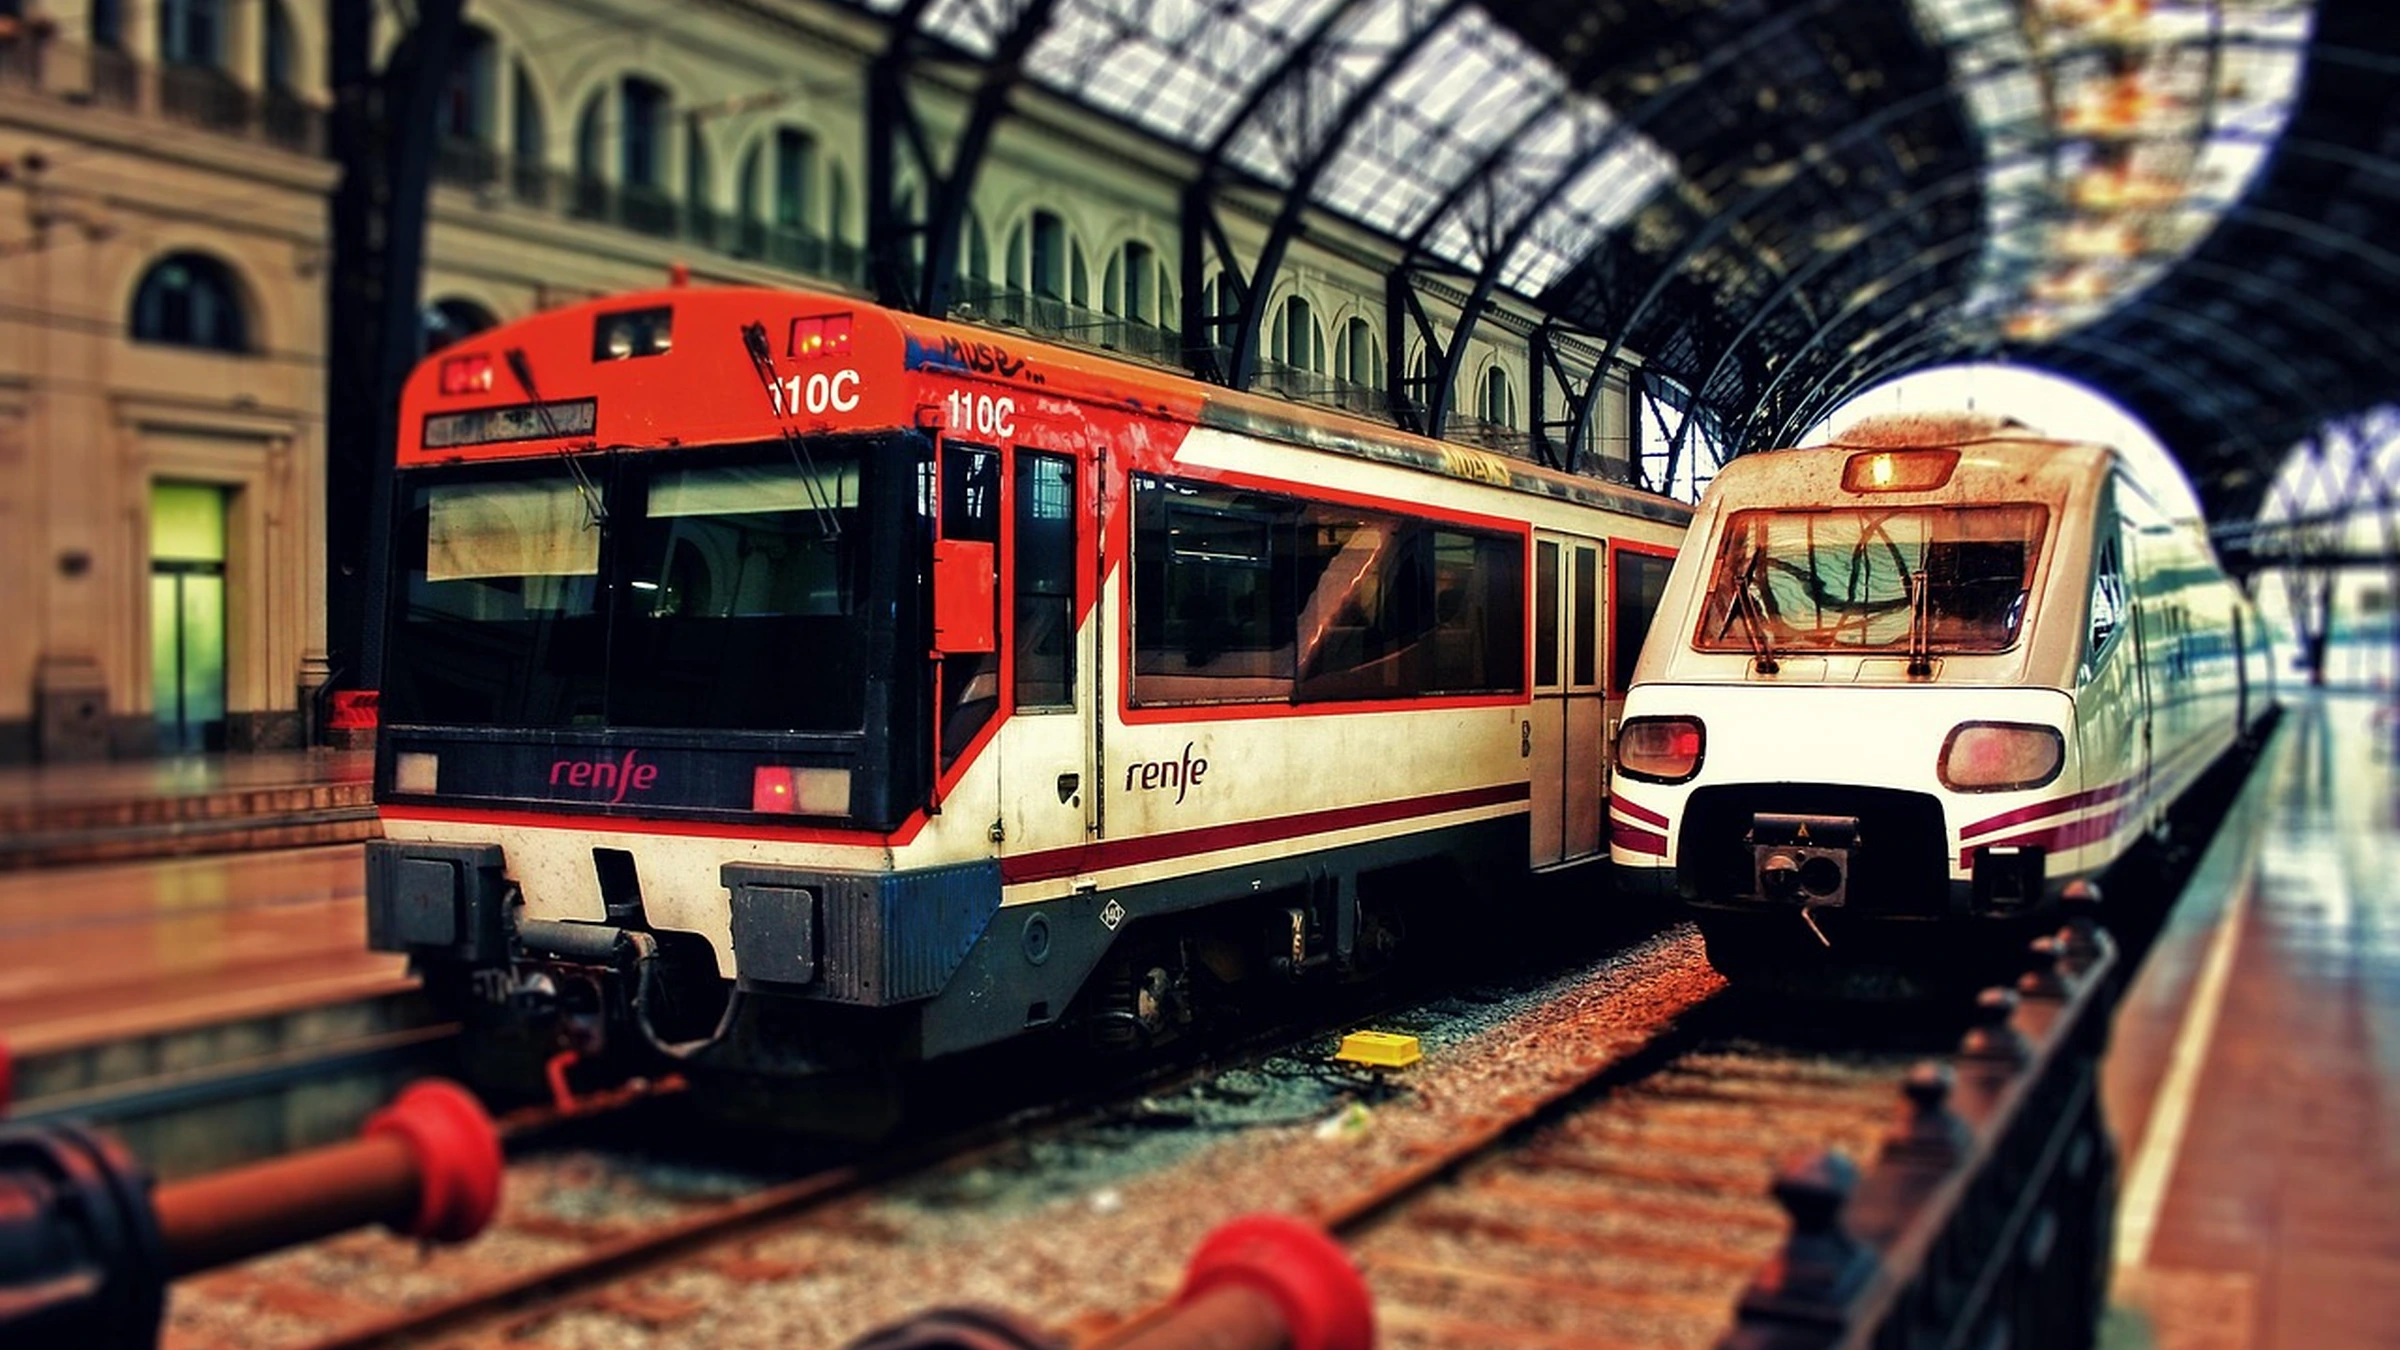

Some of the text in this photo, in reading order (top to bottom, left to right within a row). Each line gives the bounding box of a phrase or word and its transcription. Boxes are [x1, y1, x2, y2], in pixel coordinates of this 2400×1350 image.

[768, 369, 860, 415] 110C
[948, 389, 1015, 437] 110C
[549, 749, 657, 804] renfe
[1125, 741, 1208, 805] renfe
